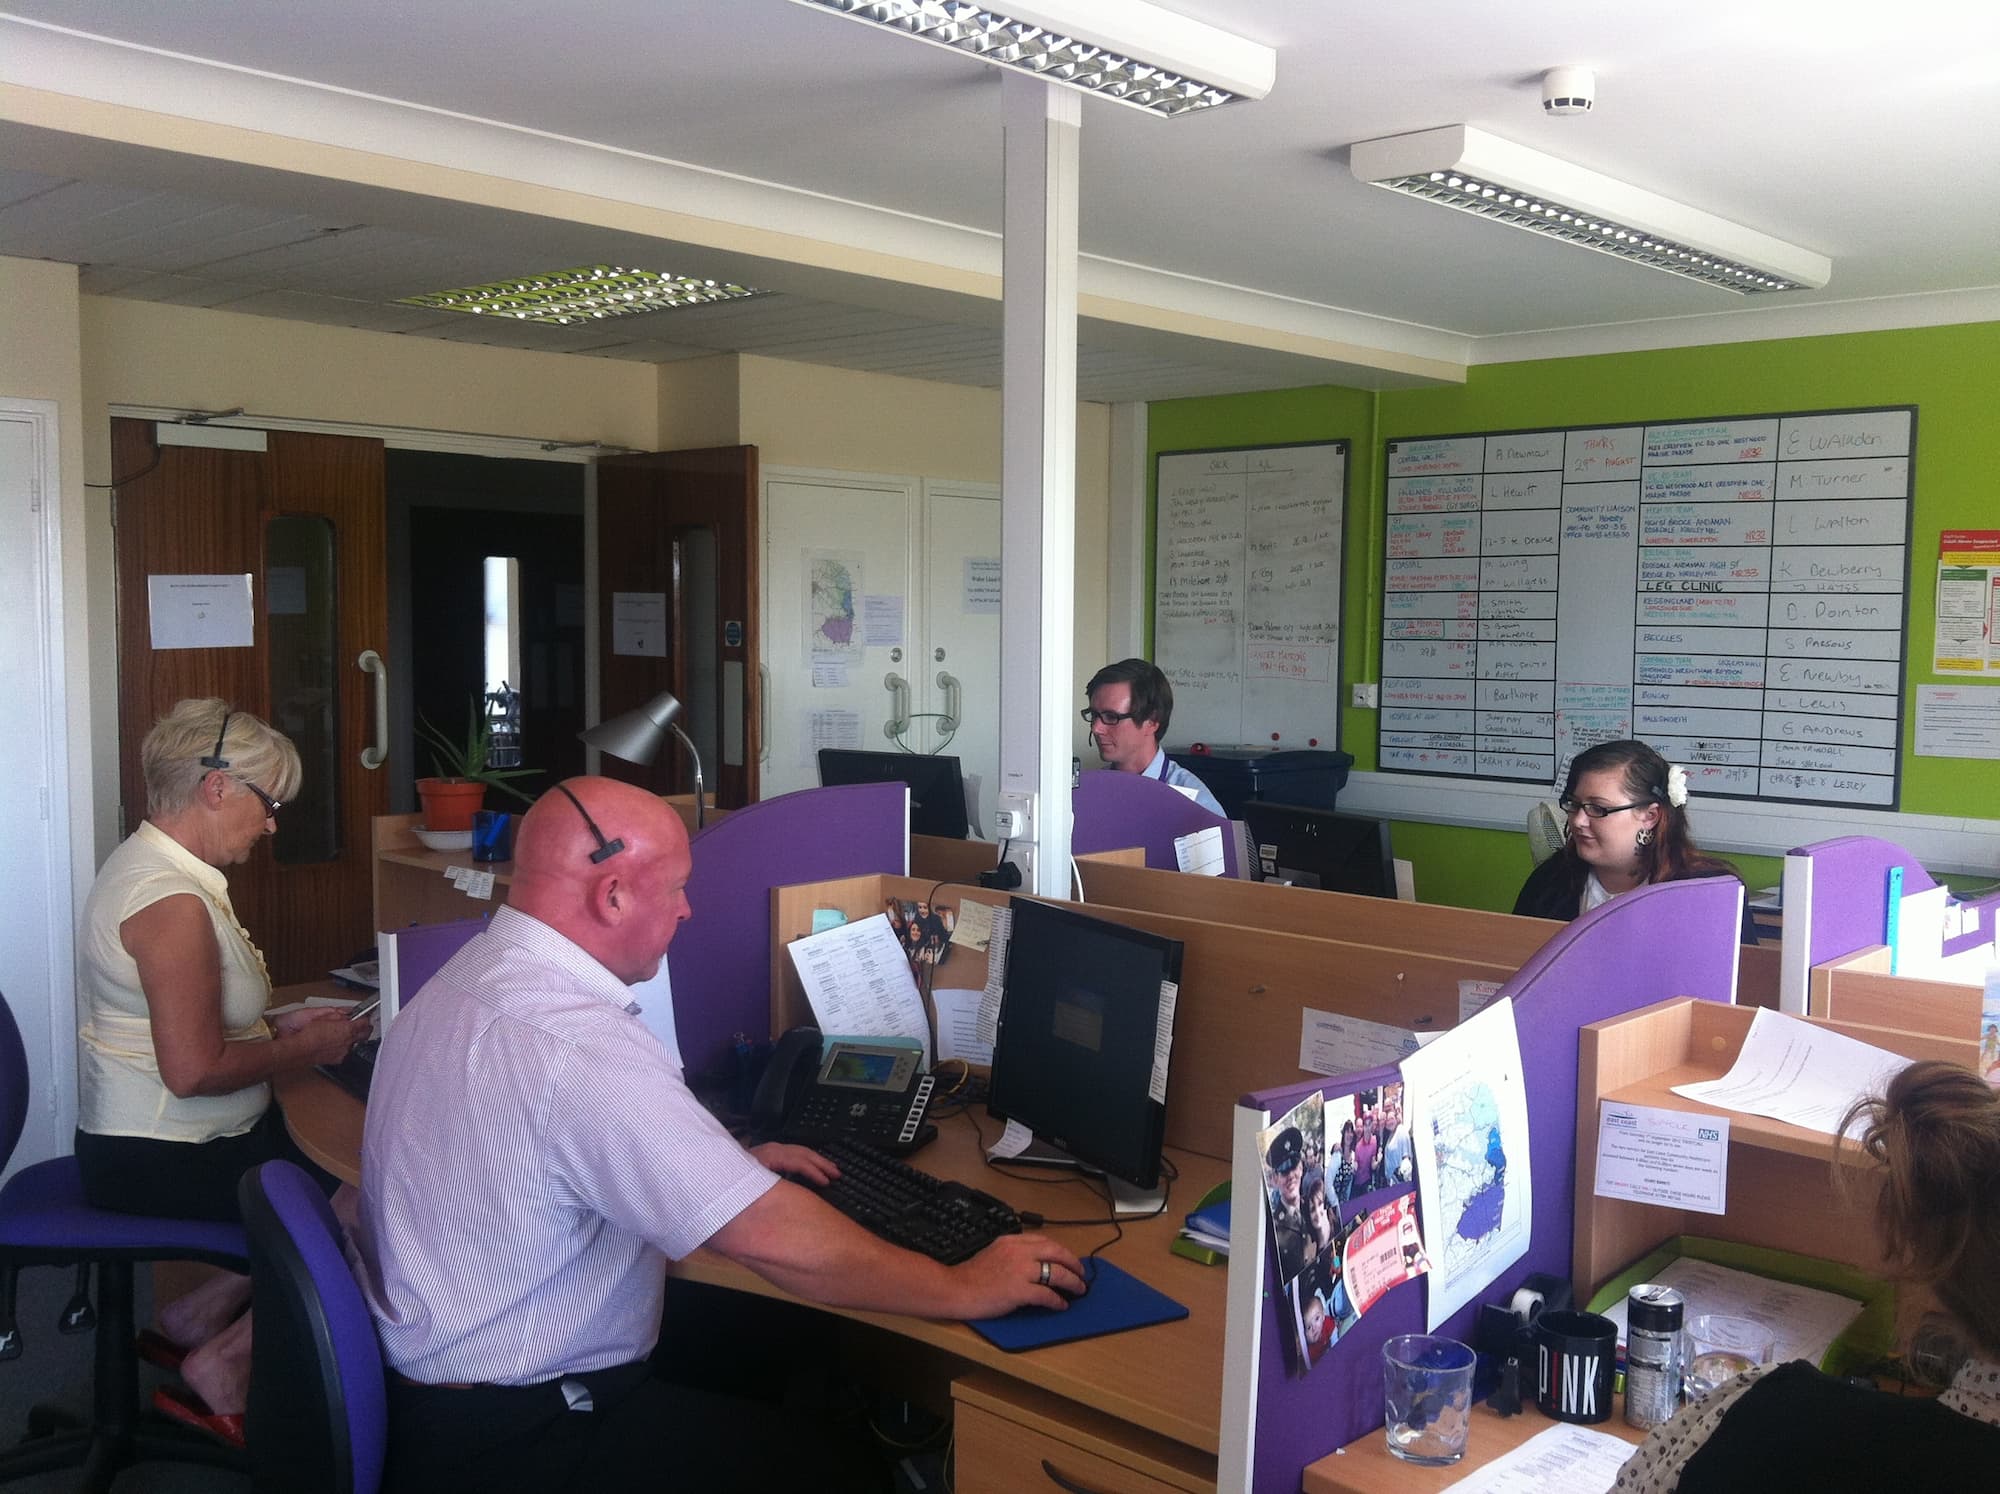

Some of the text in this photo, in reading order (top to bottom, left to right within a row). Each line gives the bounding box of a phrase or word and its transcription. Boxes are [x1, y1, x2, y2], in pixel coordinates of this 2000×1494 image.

[1811, 473, 1868, 486] Turner
[1646, 582, 1723, 591] LEG CLINIC
[1690, 752, 1731, 762] WAVENEY
[1699, 1129, 1719, 1140] NHS
